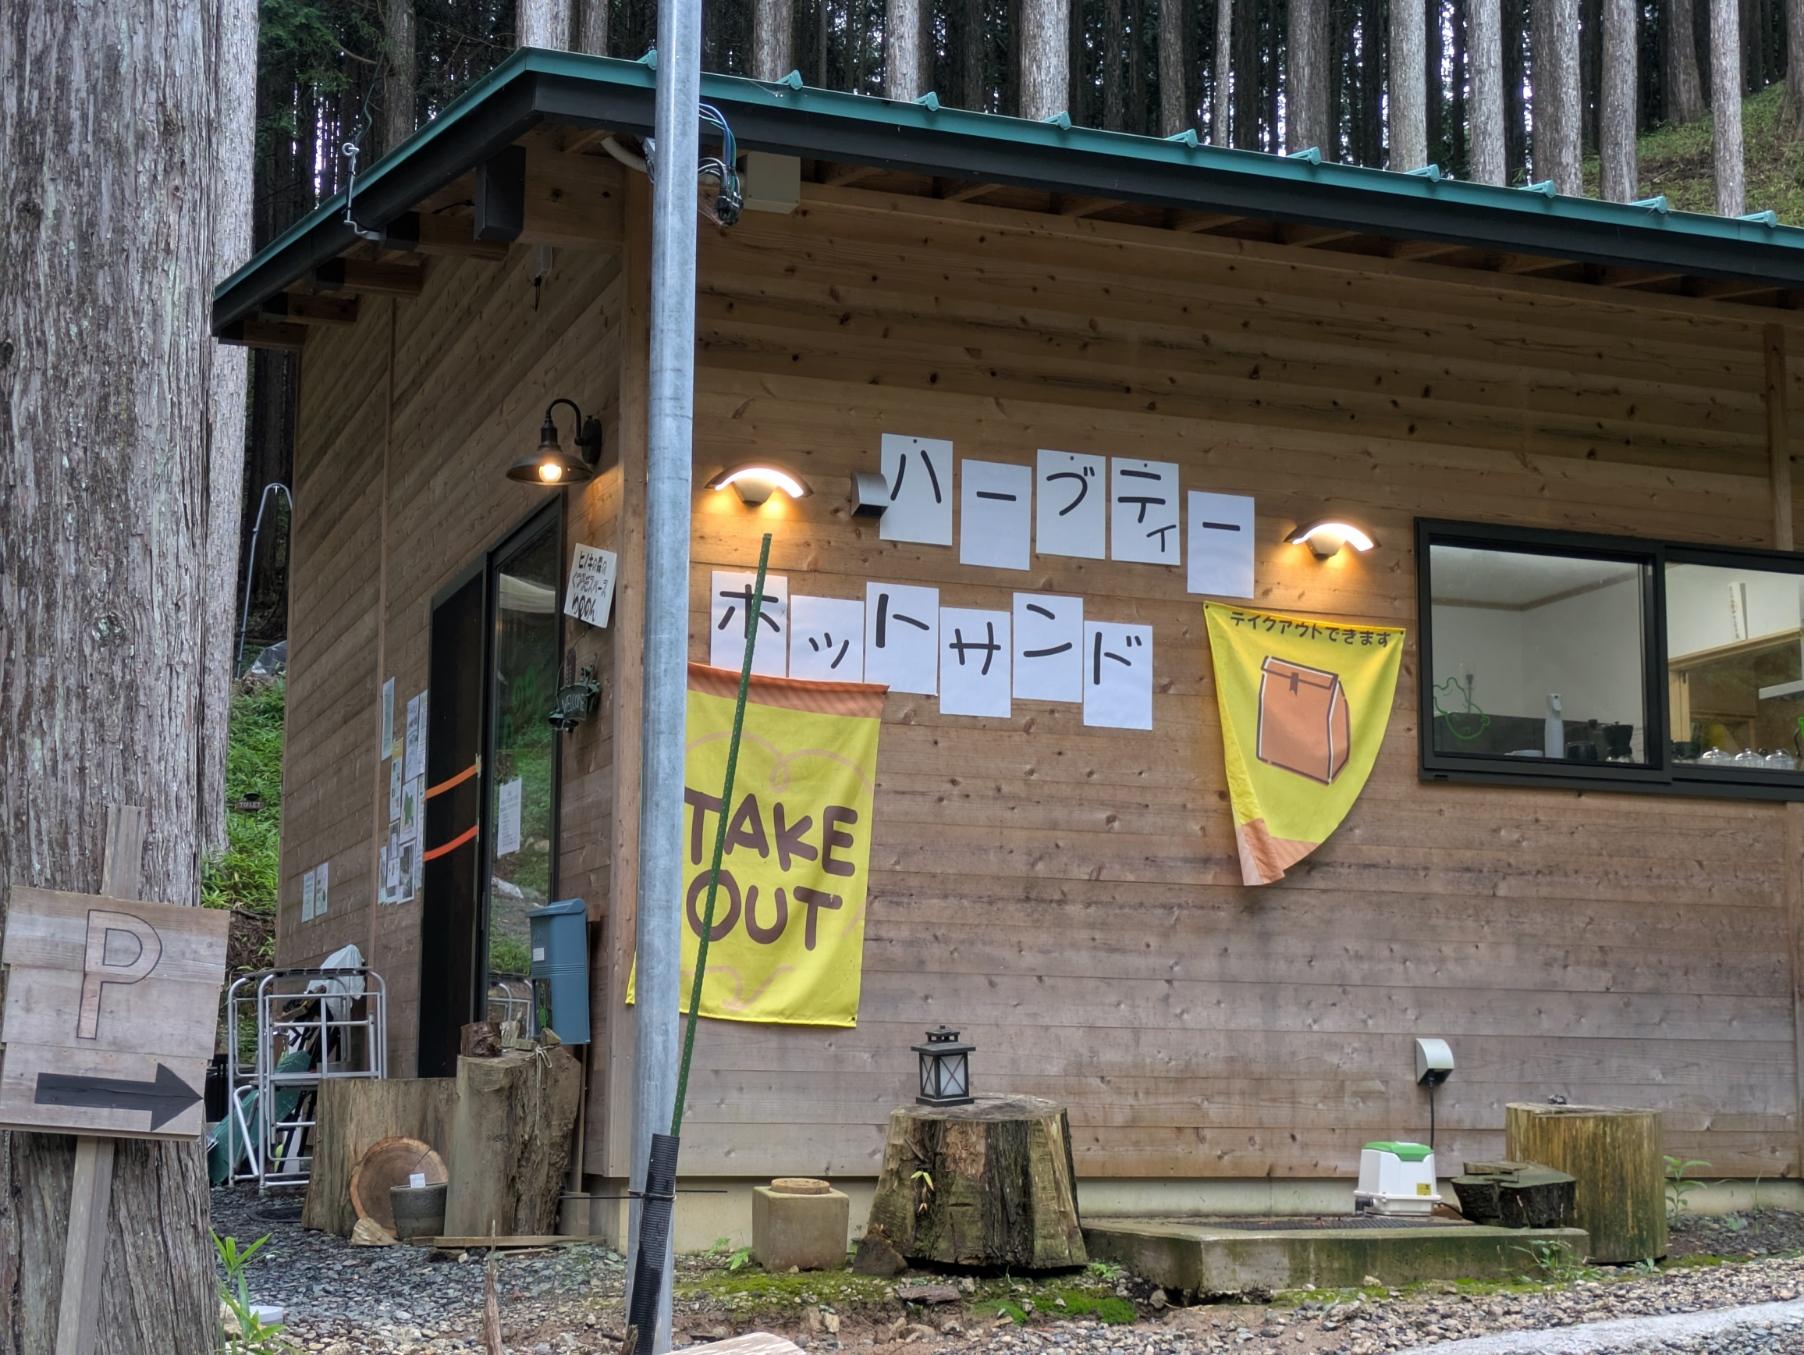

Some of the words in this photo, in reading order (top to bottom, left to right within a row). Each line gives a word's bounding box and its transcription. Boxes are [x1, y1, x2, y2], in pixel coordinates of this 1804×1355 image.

[890, 450, 1240, 552] ハーブティー
[718, 574, 1142, 685] ホットサンド
[1230, 611, 1391, 648] テイクアウトできます
[684, 786, 858, 877] TAKE
[686, 869, 843, 951] OUT
[76, 908, 163, 1040] P
